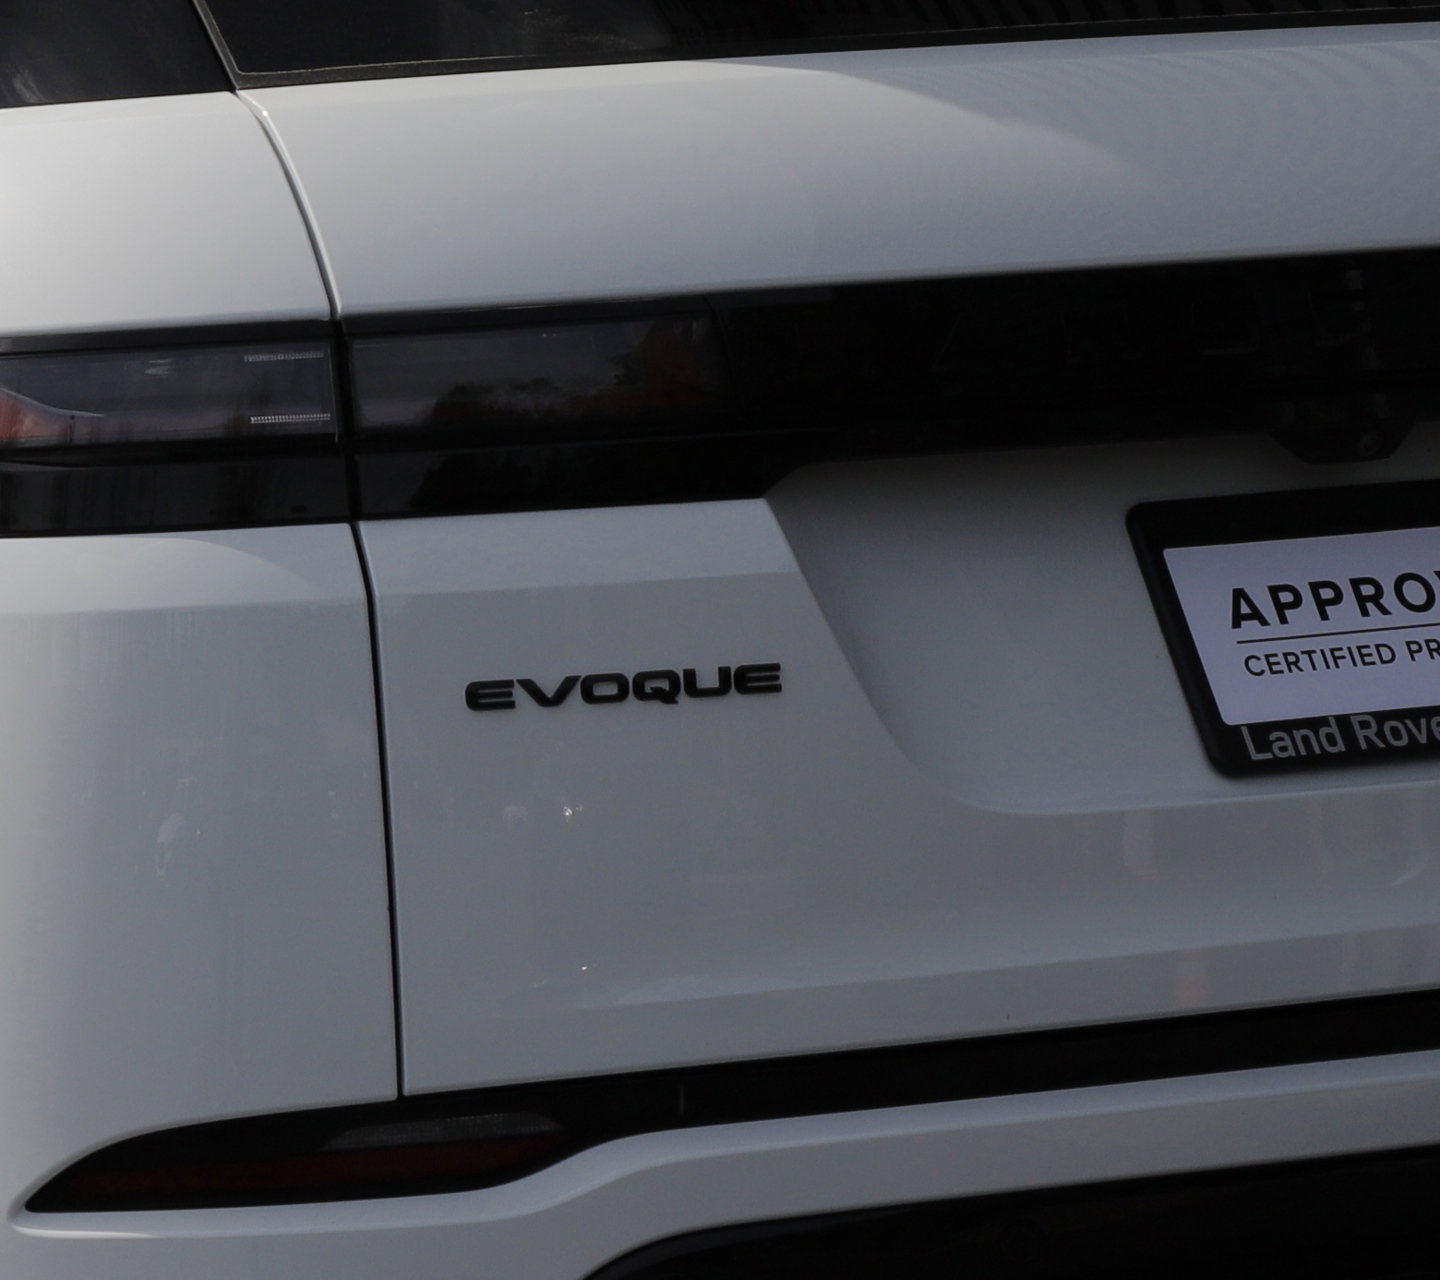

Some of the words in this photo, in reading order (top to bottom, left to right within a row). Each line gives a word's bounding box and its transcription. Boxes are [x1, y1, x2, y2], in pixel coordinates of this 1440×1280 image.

[1243, 642, 1397, 677] CERTIFIED
[465, 662, 783, 712] EVOQUE
[1241, 723, 1346, 761] Land
